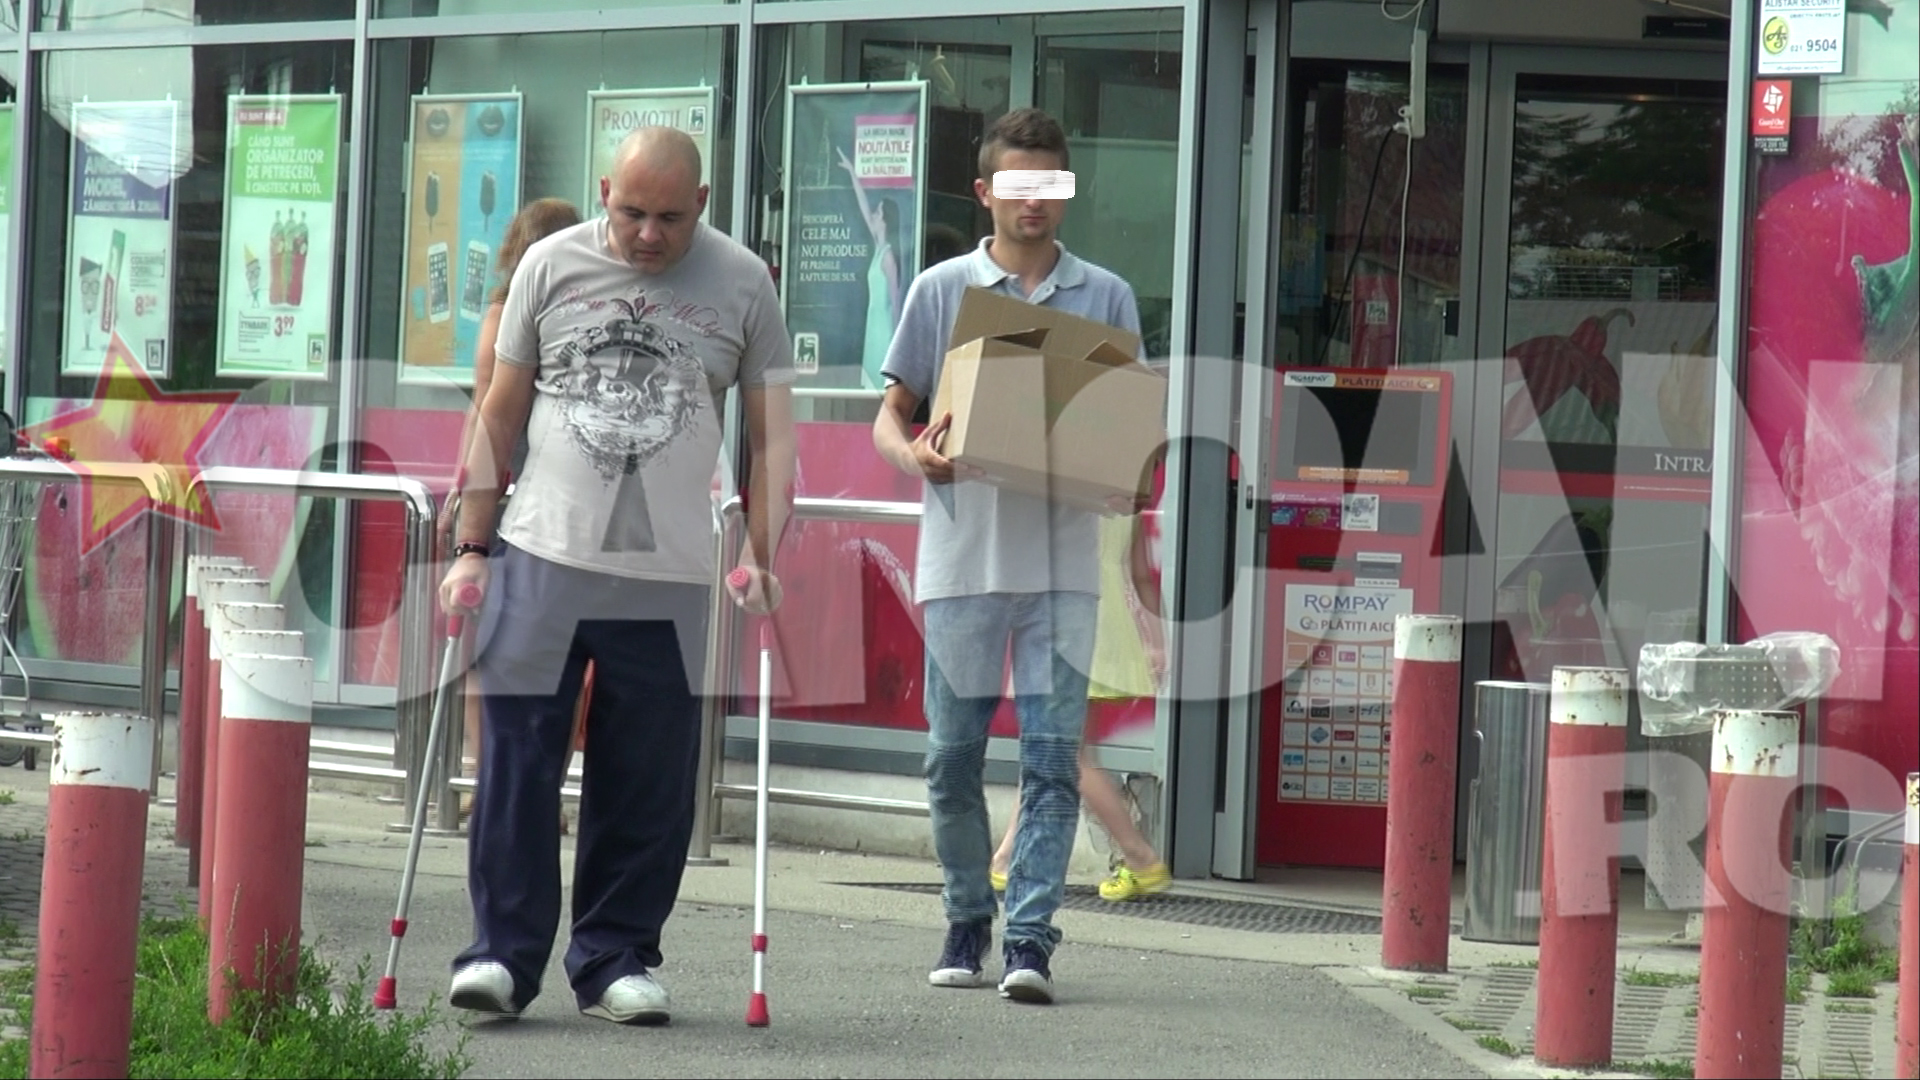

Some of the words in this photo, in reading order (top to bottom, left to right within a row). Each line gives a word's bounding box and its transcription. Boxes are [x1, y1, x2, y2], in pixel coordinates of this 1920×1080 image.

[1806, 39, 1837, 52] 9504
[246, 148, 325, 164] ORGANIZATOR
[246, 164, 260, 179] DE
[261, 164, 317, 182] PETRECERI,
[801, 227, 828, 240] CELE
[829, 227, 851, 240] MAI
[801, 244, 819, 257] NOI
[821, 244, 868, 257] PRODUSE
[1304, 593, 1389, 614] ROMPAY
[1321, 617, 1367, 634] PLĂTIȚI
